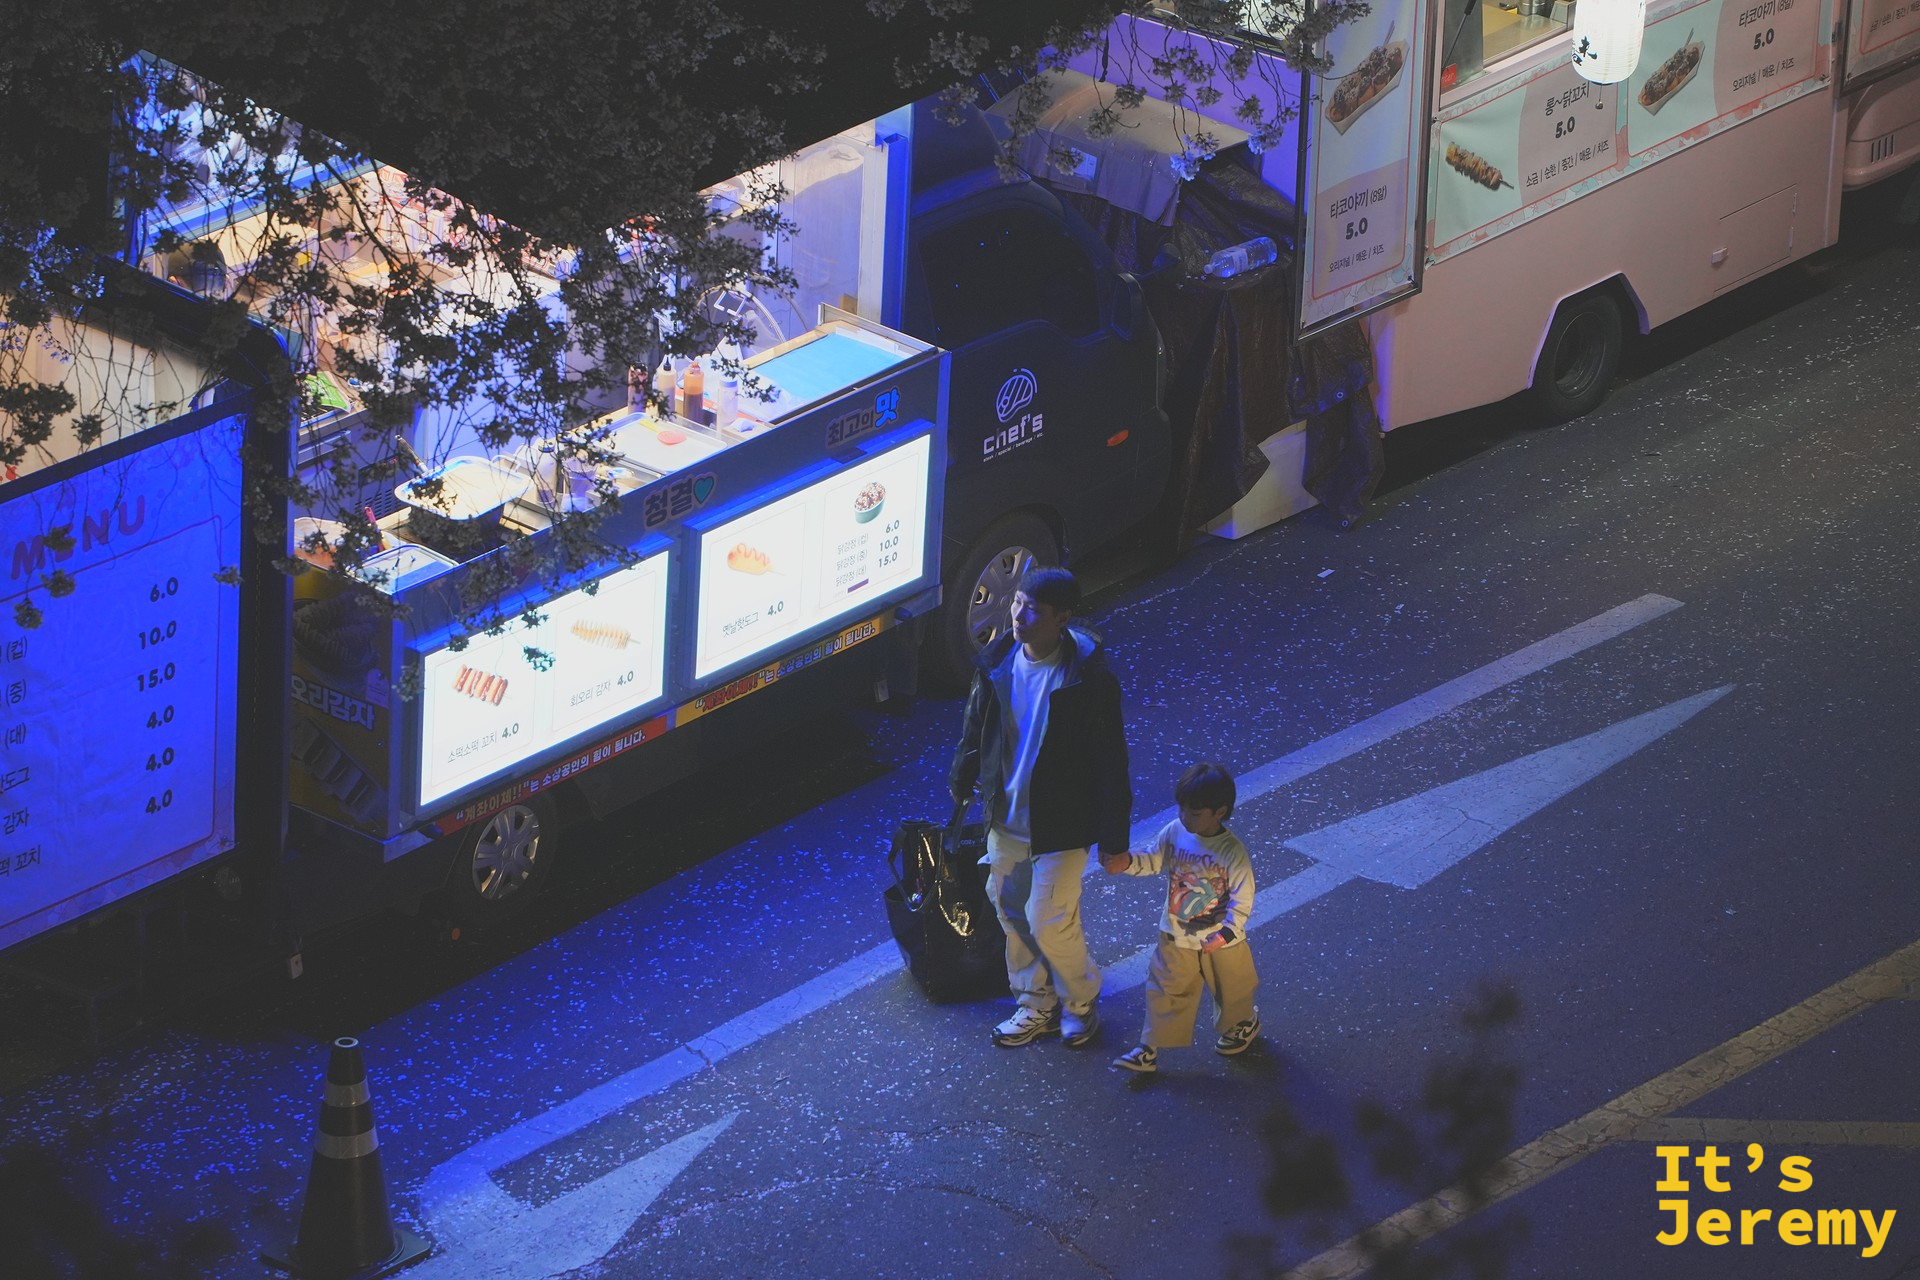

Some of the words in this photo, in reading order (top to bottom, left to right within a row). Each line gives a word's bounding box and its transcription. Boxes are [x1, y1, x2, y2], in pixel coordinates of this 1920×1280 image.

[1739, 0, 1776, 27] 타코야끼
[1753, 28, 1775, 50] 5.0
[1732, 73, 1757, 91] 오리지널
[1762, 64, 1775, 78] 매운
[1780, 58, 1795, 71] 치즈
[1555, 116, 1576, 138] 5.0
[1526, 173, 1539, 188] 소금
[1544, 163, 1557, 180] 순한
[1561, 156, 1573, 172] 중간
[1579, 147, 1591, 162] 매운
[1597, 140, 1609, 155] 치즈
[1330, 189, 1369, 219] 타코야끼
[1370, 184, 1388, 205] (8알)
[1345, 217, 1368, 240] 5.0
[1329, 257, 1351, 273] 오리지널
[1355, 249, 1368, 262] 매운
[1372, 244, 1385, 256] 치즈
[983, 413, 1043, 455] chef's
[645, 478, 693, 528] 청결
[879, 535, 899, 552] 10.0
[885, 519, 900, 534] 6.0
[878, 551, 898, 568] 15.0
[6, 635, 28, 663] (컵)
[150, 577, 178, 602] 6.0
[722, 612, 759, 638] 옛날핫도그
[767, 600, 784, 617] 4.0
[6, 678, 27, 707] (중)
[138, 620, 177, 649] 10.0
[777, 645, 822, 677] 소상공인의
[824, 636, 843, 655] 힘이
[845, 623, 876, 647] 됩니다.
[4, 722, 27, 749] (대)
[137, 662, 176, 692] 15.0
[570, 683, 594, 708] 회오리
[595, 679, 612, 698] 감자
[616, 670, 635, 687] 4.0
[0, 766, 31, 794] 도그
[146, 705, 175, 730] 4.0
[447, 736, 479, 764] 소떡소떡
[480, 729, 497, 748] 꼬치
[501, 722, 520, 739] 4.0
[542, 754, 590, 787] 소상공인의
[593, 744, 612, 763] 힘이
[614, 729, 646, 754] 됩니다.
[2, 807, 30, 836] 감자
[145, 747, 175, 772] 4.0
[14, 844, 42, 873] 꼬치
[144, 789, 173, 814] 4.0
